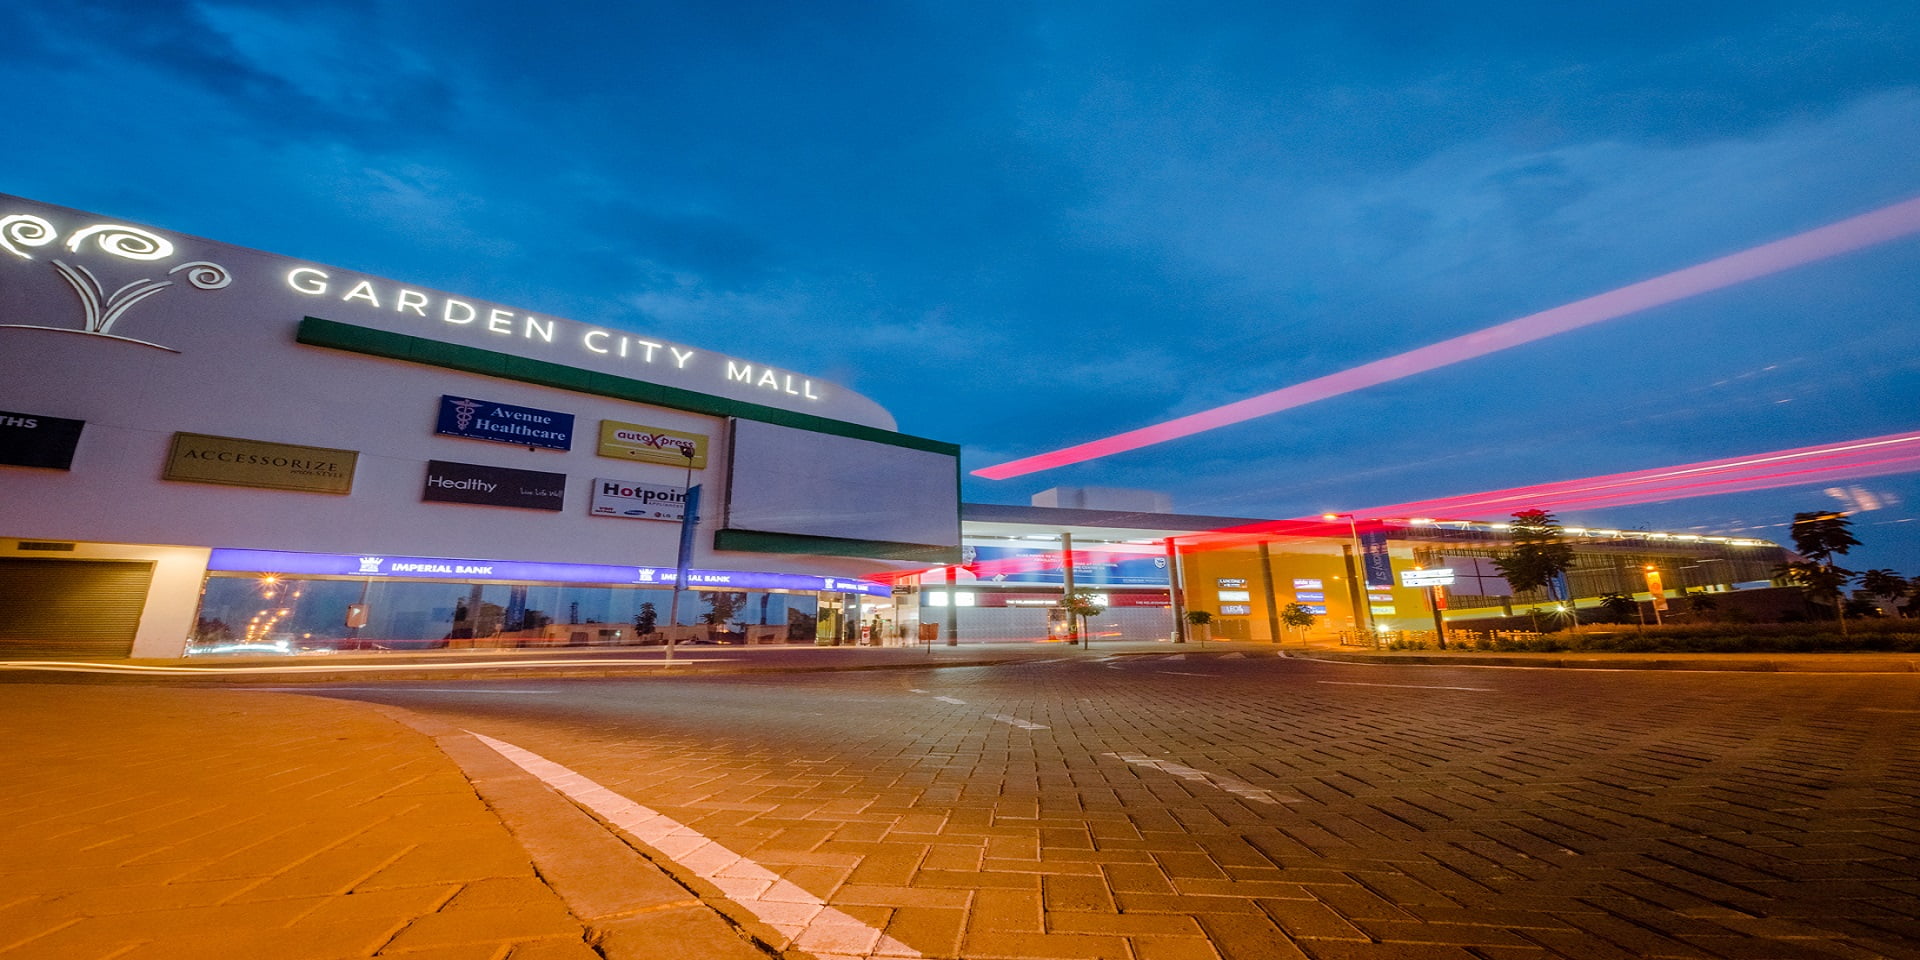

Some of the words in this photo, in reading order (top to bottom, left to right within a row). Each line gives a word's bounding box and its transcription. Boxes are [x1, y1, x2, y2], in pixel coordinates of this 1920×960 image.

[286, 266, 553, 343] GARDEN
[584, 330, 694, 369] CITY
[727, 361, 819, 400] MALL
[490, 407, 552, 425] Avenue
[475, 418, 566, 441] Healthcare
[617, 431, 695, 450] autoXpress
[183, 450, 338, 472] ACCESSORIZE
[427, 475, 497, 493] Healthy
[603, 482, 688, 505] Hotpoin
[391, 562, 453, 574] IMPERIAL
[455, 565, 493, 575] BANK
[661, 573, 702, 582] IMPIAL
[704, 575, 730, 583] BANK
